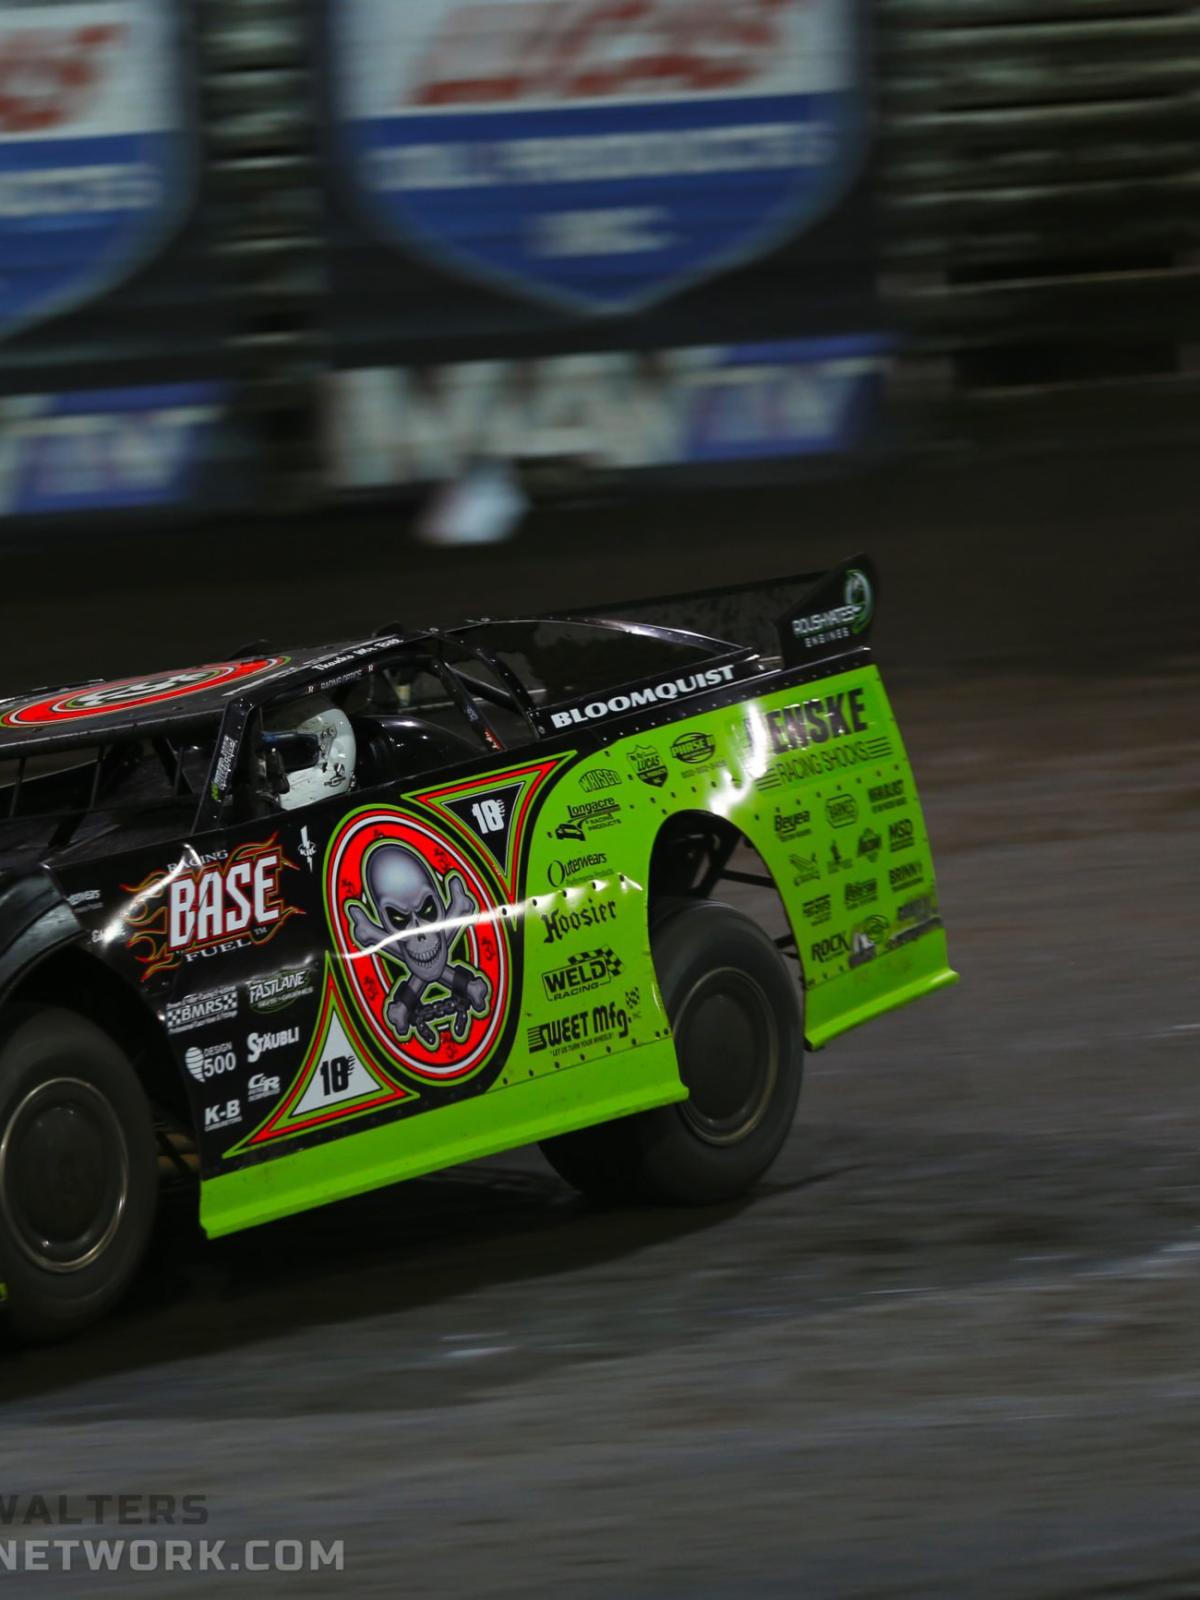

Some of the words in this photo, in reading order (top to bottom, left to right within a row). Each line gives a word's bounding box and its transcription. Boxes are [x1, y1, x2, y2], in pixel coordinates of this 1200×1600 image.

[805, 627, 849, 648] ENGINES
[551, 665, 735, 729] BLOOMQUIST
[744, 688, 868, 762] ENSKE
[637, 755, 660, 772] LUCAS
[775, 754, 822, 784] RACING
[821, 741, 870, 772] SHOCKS
[567, 797, 615, 818] Longacre
[774, 811, 810, 834] Beyea
[547, 853, 607, 887] Outerwears
[169, 855, 280, 950] BASE
[542, 898, 617, 943] Hoosier
[186, 939, 251, 963] FUEL
[250, 971, 306, 1004] FASTLANE
[544, 960, 608, 994] WELD
[553, 982, 600, 1001] RACING
[181, 998, 224, 1021] BMRS
[528, 1010, 589, 1054] SWEET
[592, 1002, 632, 1038] Mfg.
[203, 1041, 232, 1056] DESIGN
[247, 1026, 300, 1063] STÄUBLI
[203, 1052, 236, 1078] 500
[205, 1099, 240, 1125] K-B
